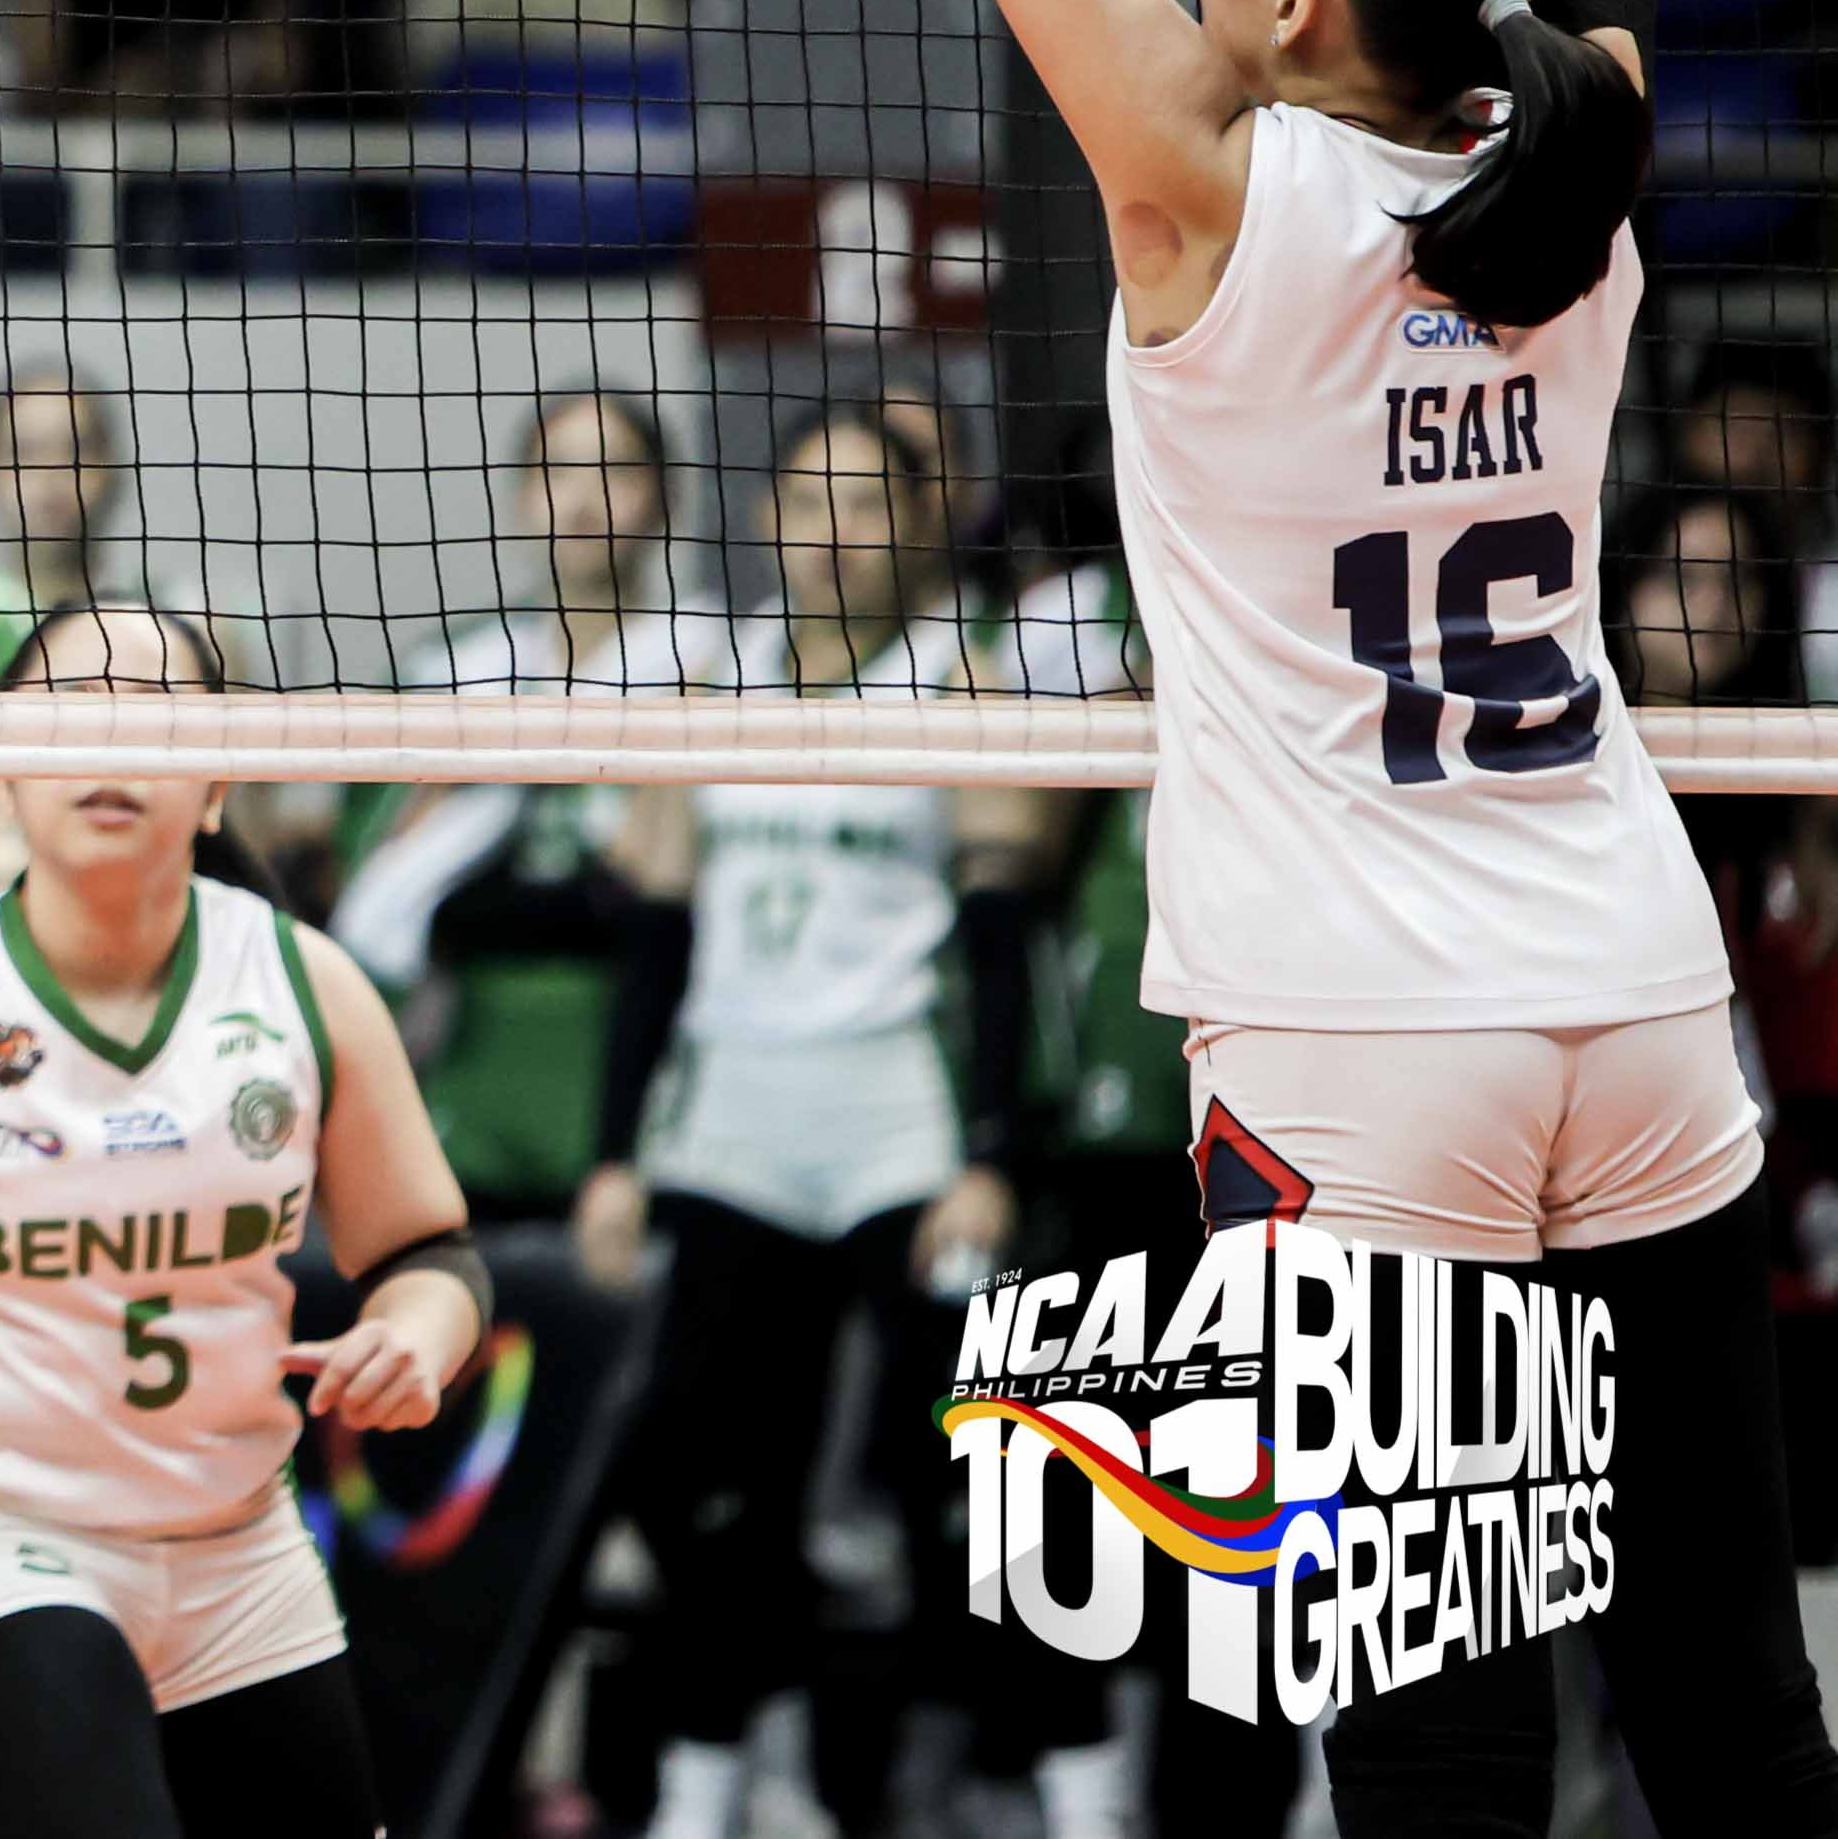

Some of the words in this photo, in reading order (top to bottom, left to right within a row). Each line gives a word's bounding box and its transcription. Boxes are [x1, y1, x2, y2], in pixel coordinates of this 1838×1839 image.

[1404, 314, 1500, 346] GMA
[1383, 373, 1544, 486] ISAR
[1333, 511, 1603, 785] 16
[123, 1294, 191, 1411] 5
